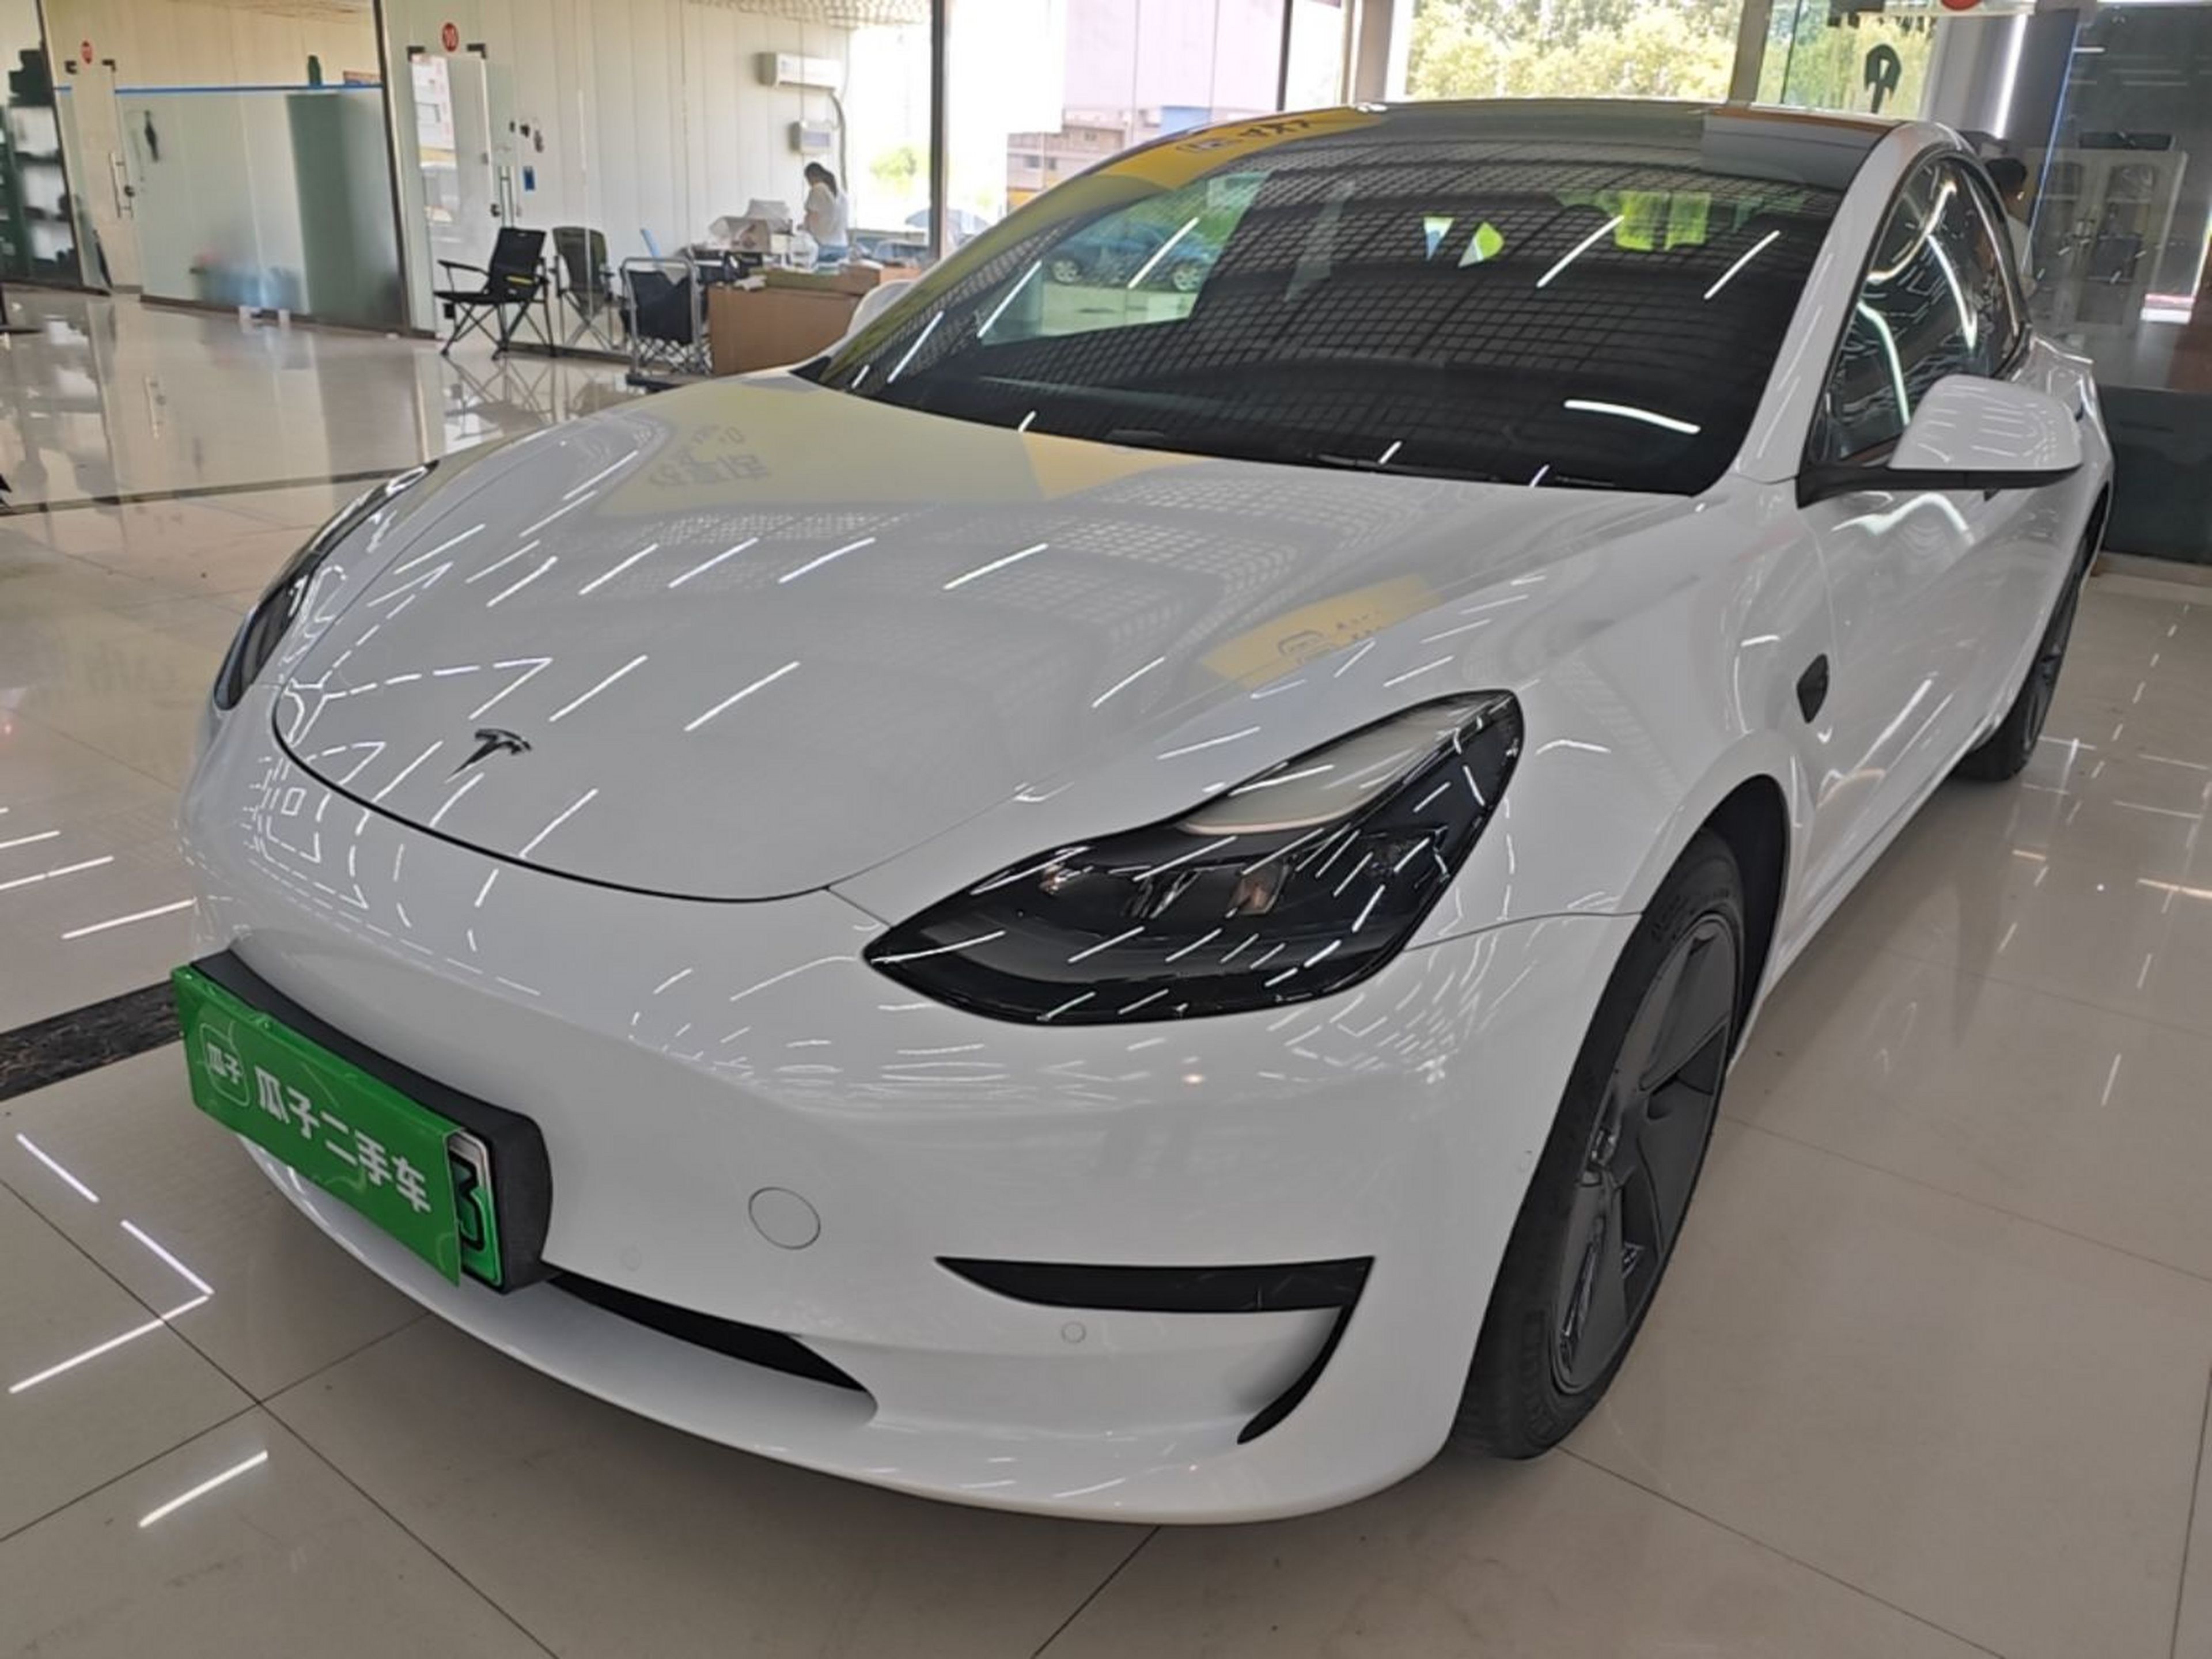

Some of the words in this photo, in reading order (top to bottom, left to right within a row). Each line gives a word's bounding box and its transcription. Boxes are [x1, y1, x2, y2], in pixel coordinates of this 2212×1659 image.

[207, 1041, 241, 1085] 瓜子
[254, 1065, 431, 1213] 瓜子二手车
